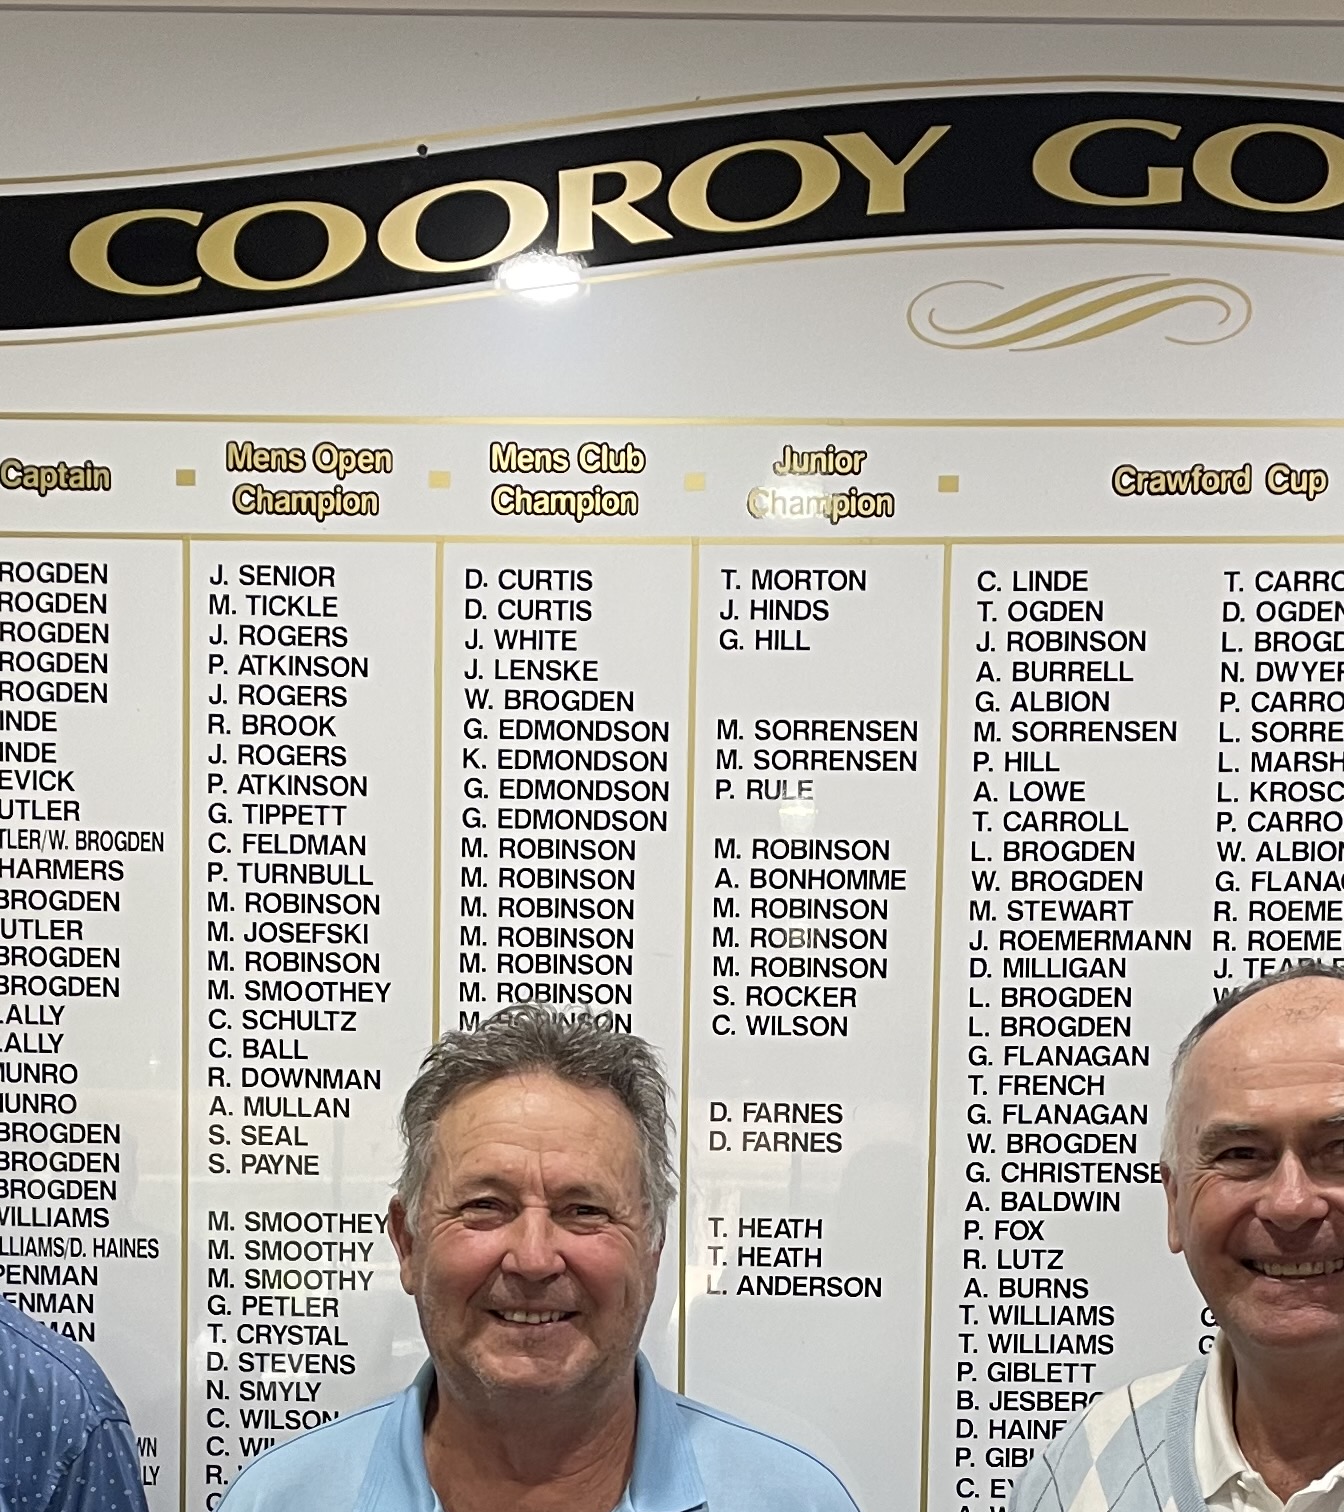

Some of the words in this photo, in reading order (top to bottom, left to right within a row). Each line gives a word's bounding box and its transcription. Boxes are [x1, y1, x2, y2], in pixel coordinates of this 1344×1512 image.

[69, 125, 952, 295] COOROY
[226, 441, 306, 473] Mens
[312, 442, 394, 478] Open
[490, 441, 570, 473] Mens
[577, 442, 646, 474] Club
[773, 444, 868, 476] Junior
[1112, 463, 1253, 497] Crawford
[1265, 463, 1329, 500] Cup
[232, 483, 380, 522] Champion
[491, 484, 639, 522] Champion
[209, 563, 229, 586] J.
[238, 564, 336, 588] SENIOR
[465, 568, 488, 590] D.
[498, 568, 593, 592] CURTIS
[720, 568, 741, 590] T.
[751, 568, 867, 592] MORTON
[1223, 570, 1244, 593] T.
[208, 653, 229, 675] P.
[237, 653, 369, 678] ATKINSON
[463, 658, 484, 680] J.
[494, 658, 599, 682] LENSKE
[975, 660, 1001, 683] A.
[1012, 660, 1134, 683] BURRELL
[717, 718, 744, 741] M.
[754, 719, 918, 742] SORRENSEN
[462, 747, 487, 770] K.
[497, 748, 668, 773] EDMONDSON
[1217, 781, 1239, 803] L.
[714, 867, 740, 889] A.
[750, 867, 907, 891] BONHOMME
[1215, 870, 1241, 893] G.
[969, 899, 997, 922] M.
[1007, 899, 1134, 922] STEWART
[207, 920, 235, 942] M.
[243, 921, 369, 945] JOSEFSKI
[208, 1008, 232, 1030] C.
[242, 1009, 357, 1032] SCHULTZ
[967, 1074, 988, 1096] T.
[998, 1074, 1105, 1096] FRENCH
[709, 1101, 732, 1123] D.
[743, 1102, 844, 1125] FARNES
[964, 1190, 990, 1212] A.
[1001, 1190, 1120, 1213] BALDWIN
[206, 1351, 229, 1372] D.
[238, 1351, 356, 1375] STEVENS
